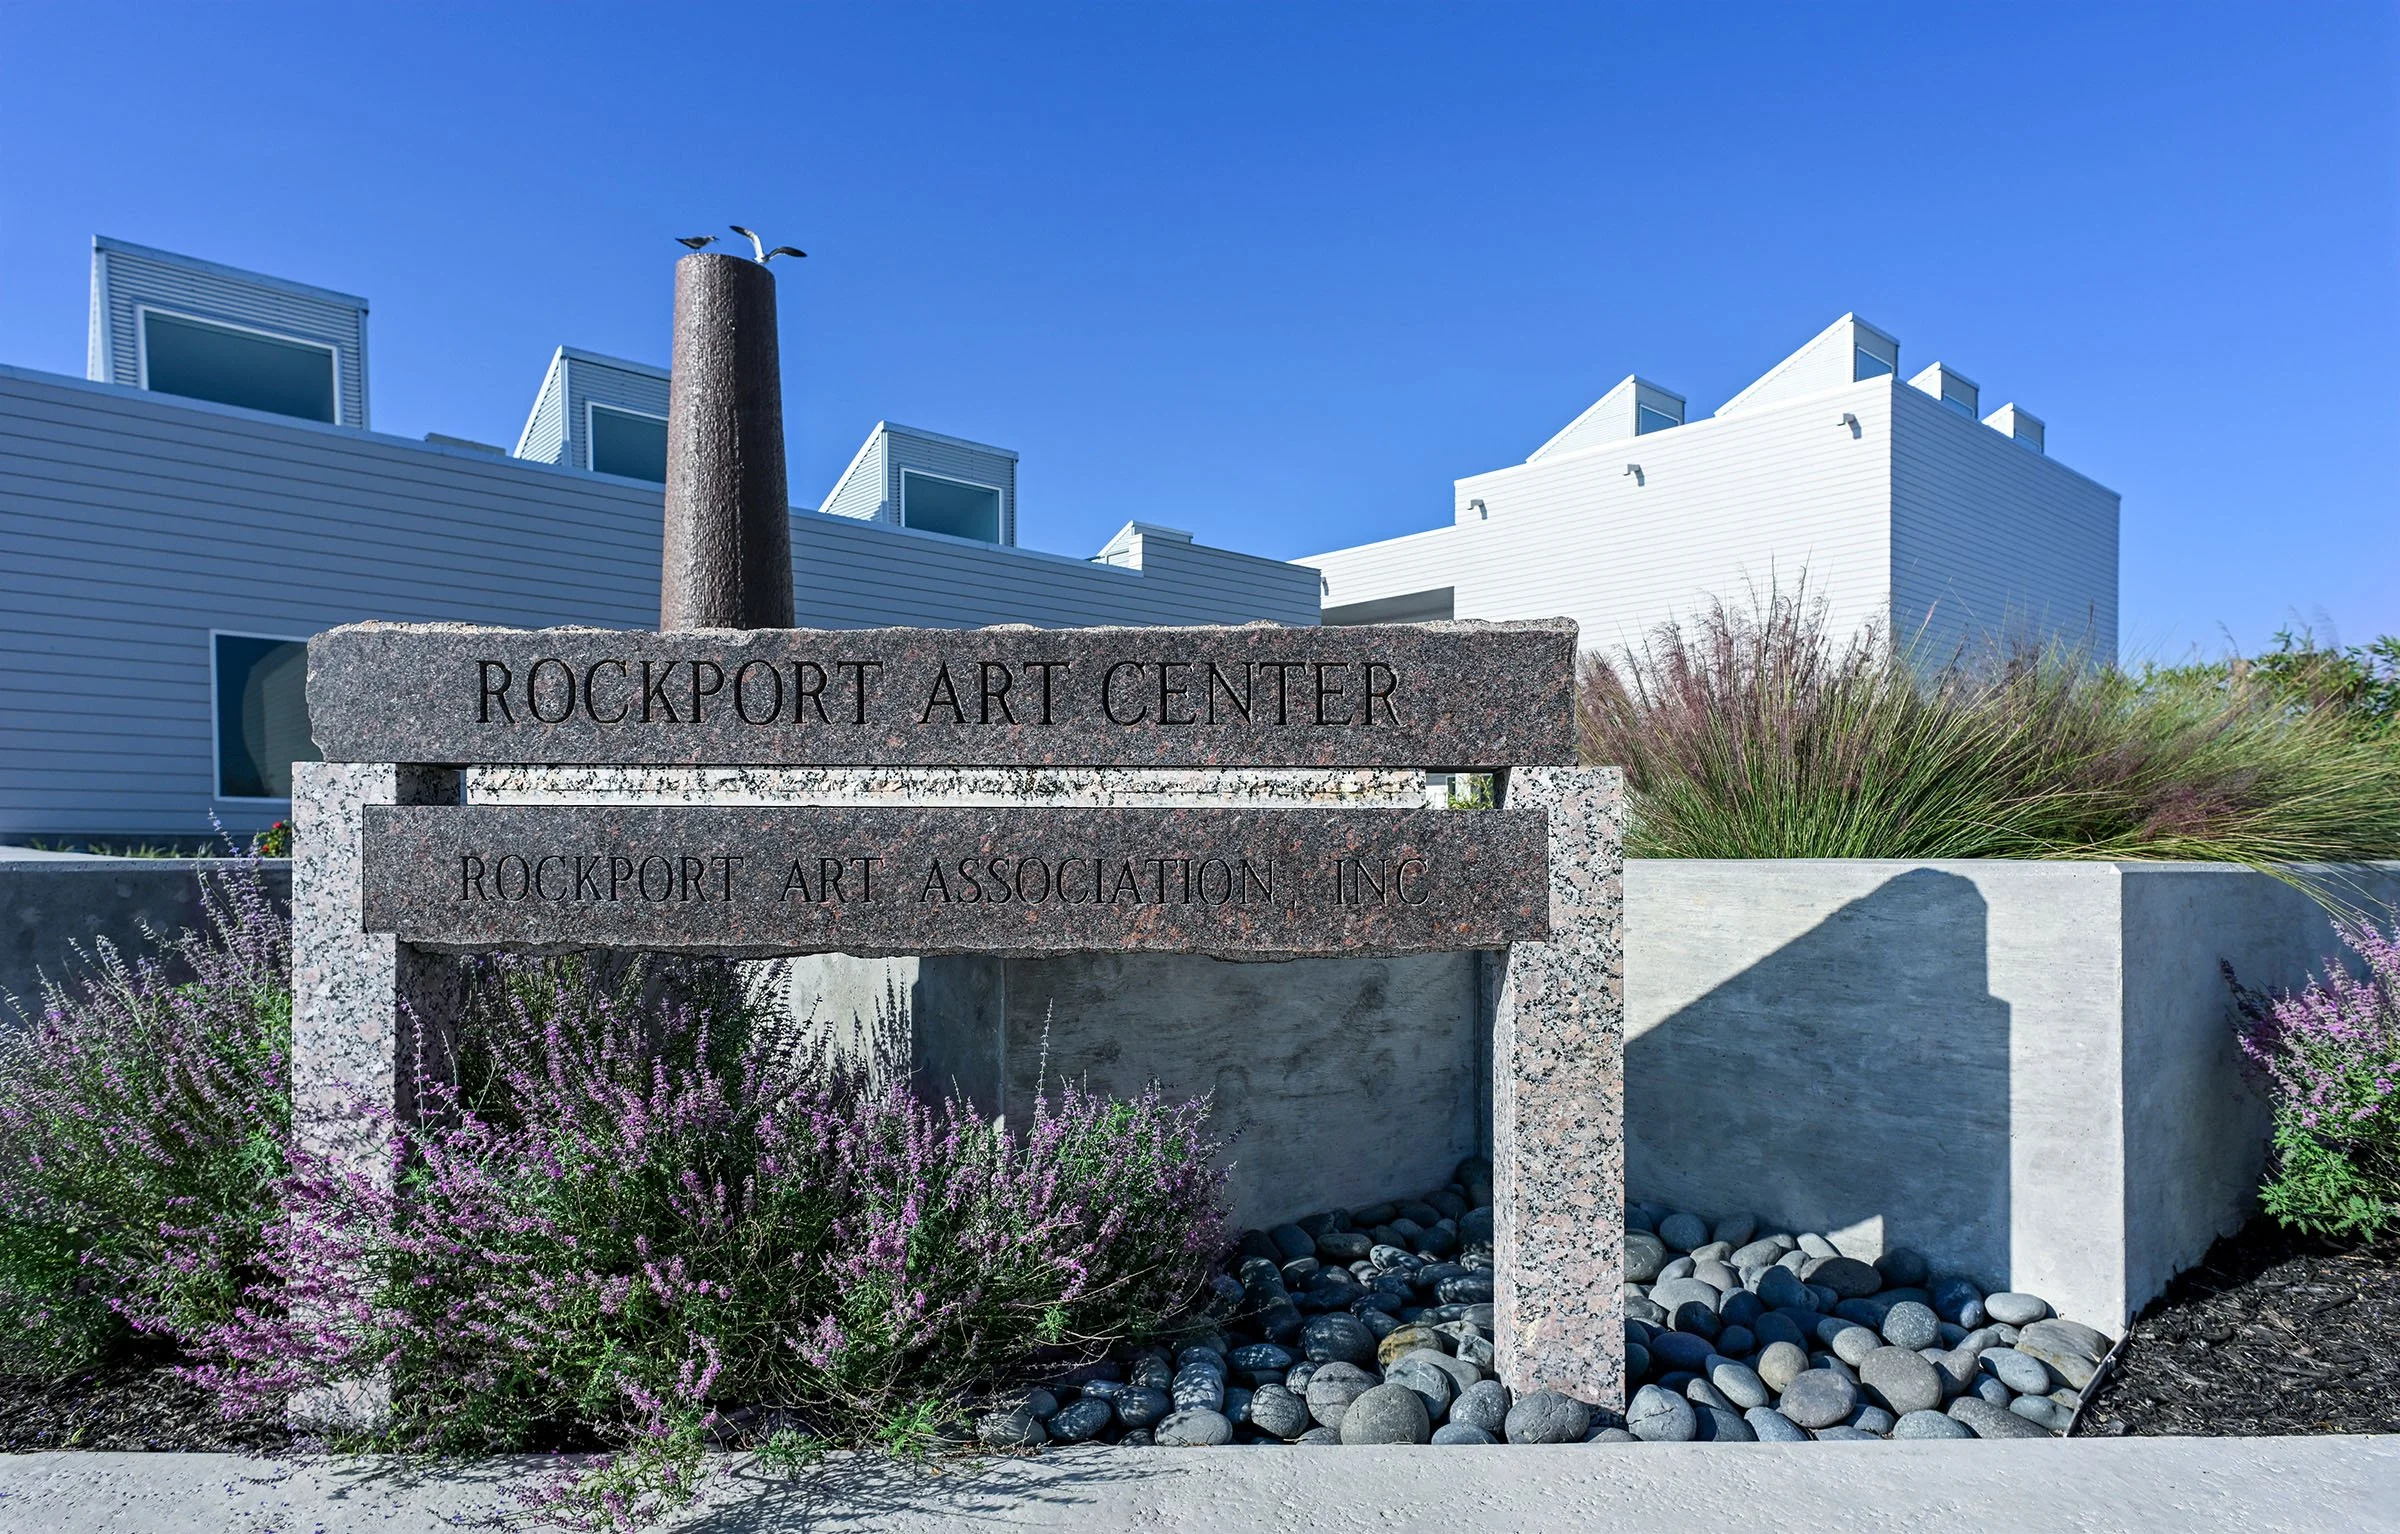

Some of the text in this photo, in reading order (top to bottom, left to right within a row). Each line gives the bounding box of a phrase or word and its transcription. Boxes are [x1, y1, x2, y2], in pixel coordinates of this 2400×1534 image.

[476, 657, 1401, 726] ROCKPORT ART CENTER
[459, 854, 744, 902] ROCKPORT
[780, 856, 884, 904] ART
